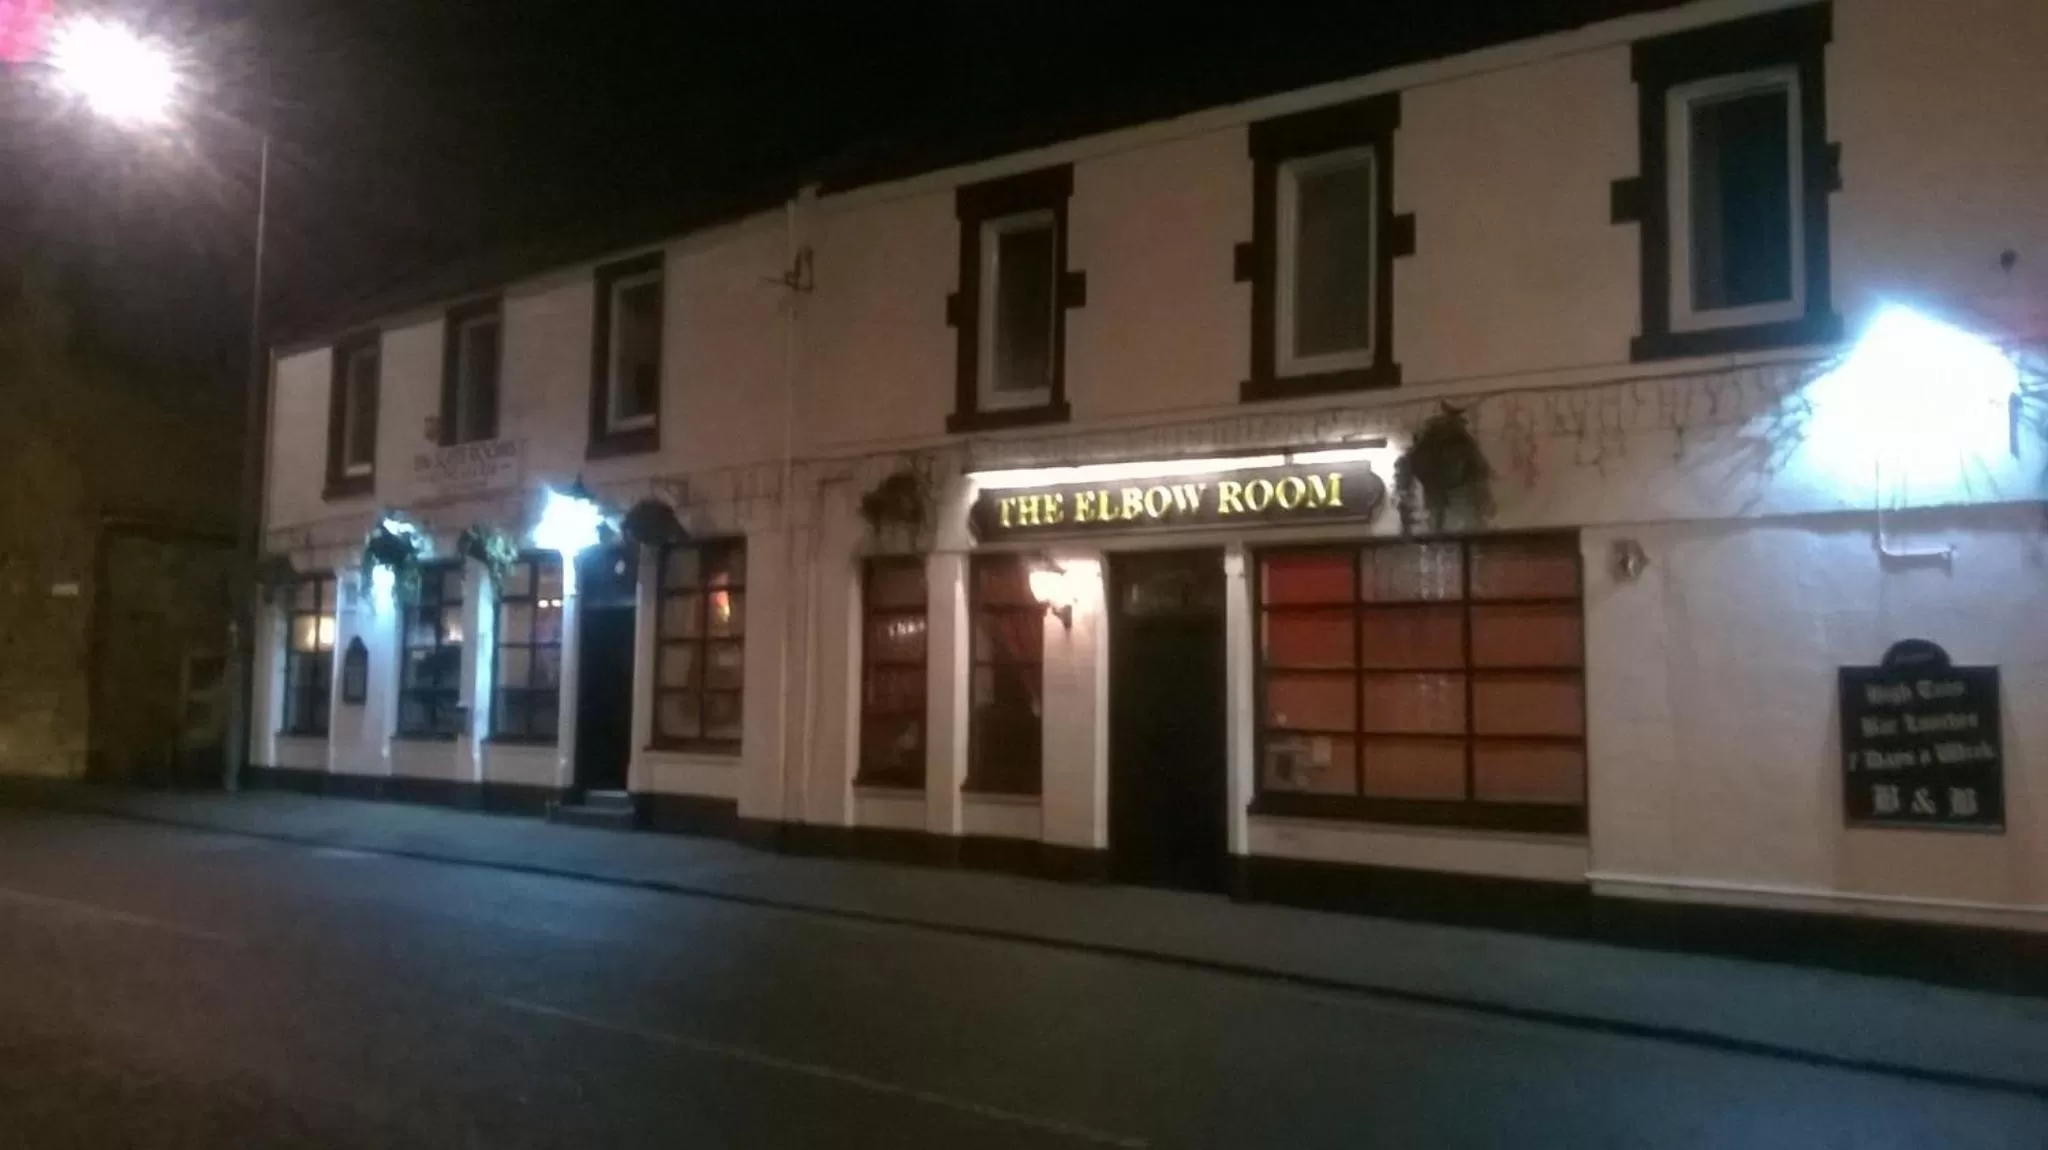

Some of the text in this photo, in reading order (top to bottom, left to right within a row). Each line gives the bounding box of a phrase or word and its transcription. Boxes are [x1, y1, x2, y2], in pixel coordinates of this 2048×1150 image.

[999, 473, 1344, 528] THE ELBOW ROOM
[1911, 787, 1937, 815] &
